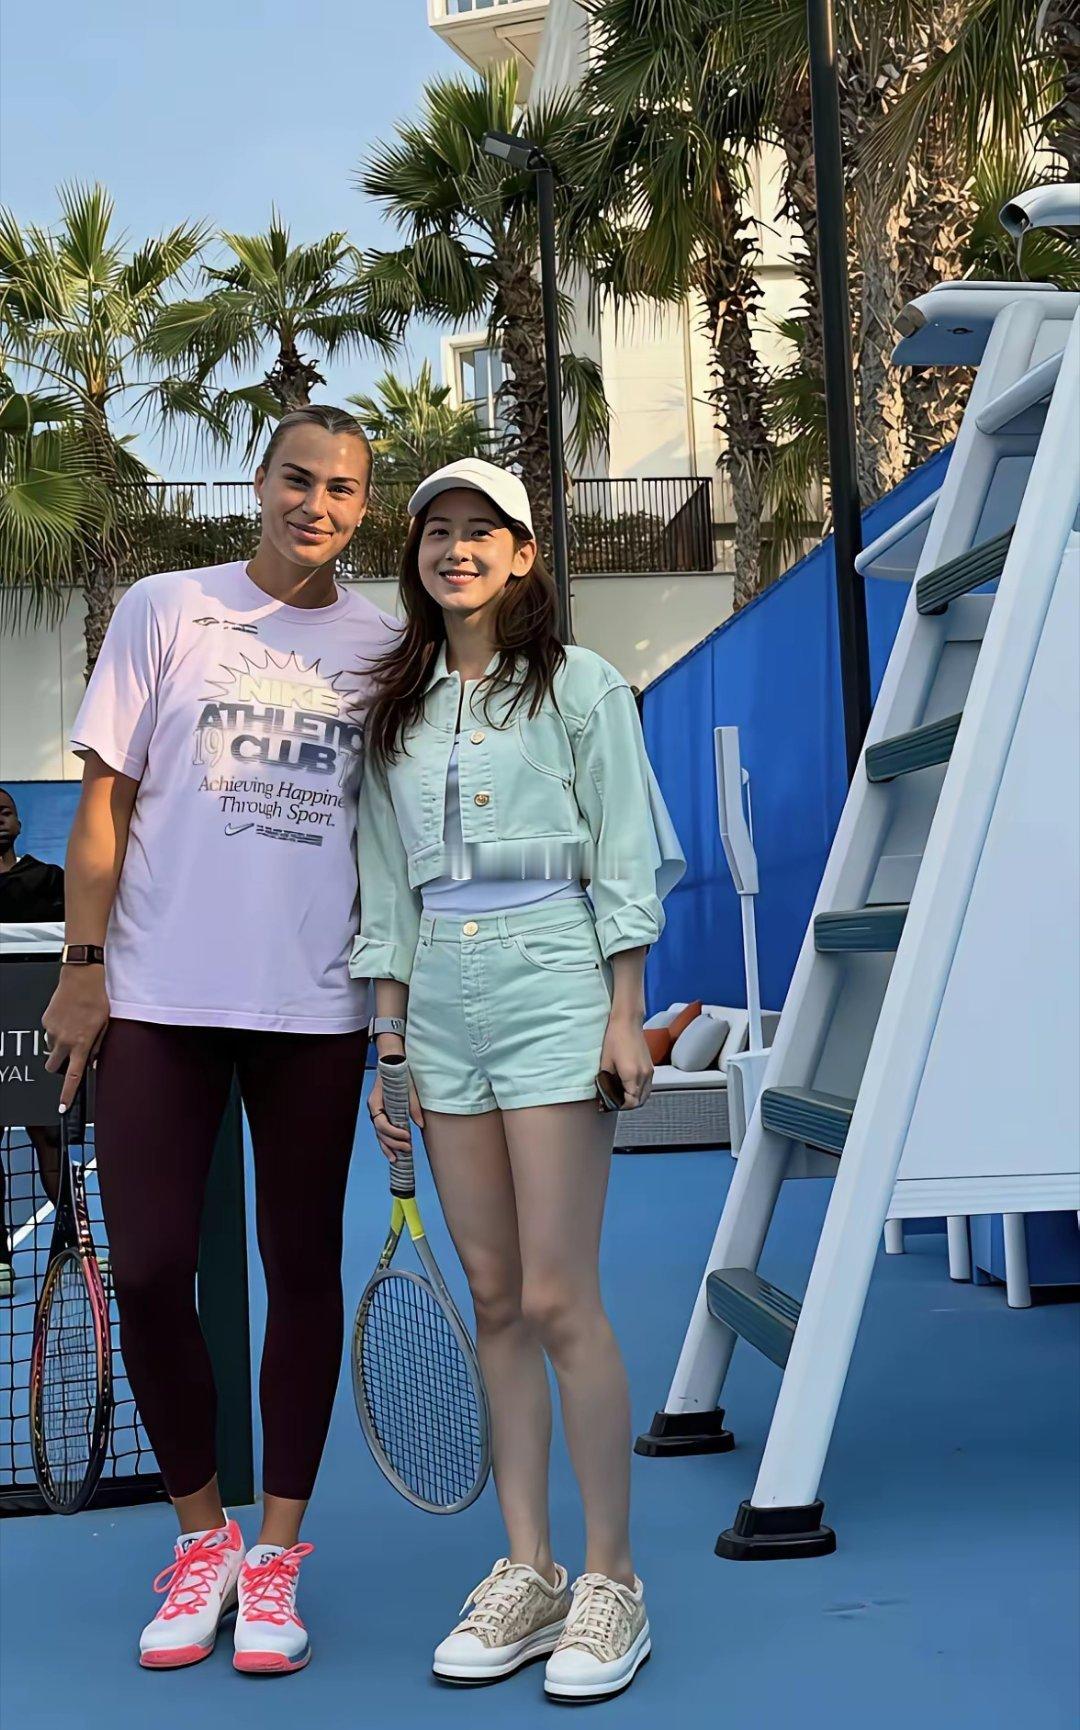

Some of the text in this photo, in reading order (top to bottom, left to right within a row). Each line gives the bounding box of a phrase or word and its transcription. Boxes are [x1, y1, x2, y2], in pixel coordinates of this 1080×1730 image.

[237, 672, 340, 717] NIKE
[193, 727, 224, 768] 19
[231, 734, 337, 775] CLUB
[198, 775, 274, 799] Achieving
[219, 796, 282, 819] Through
